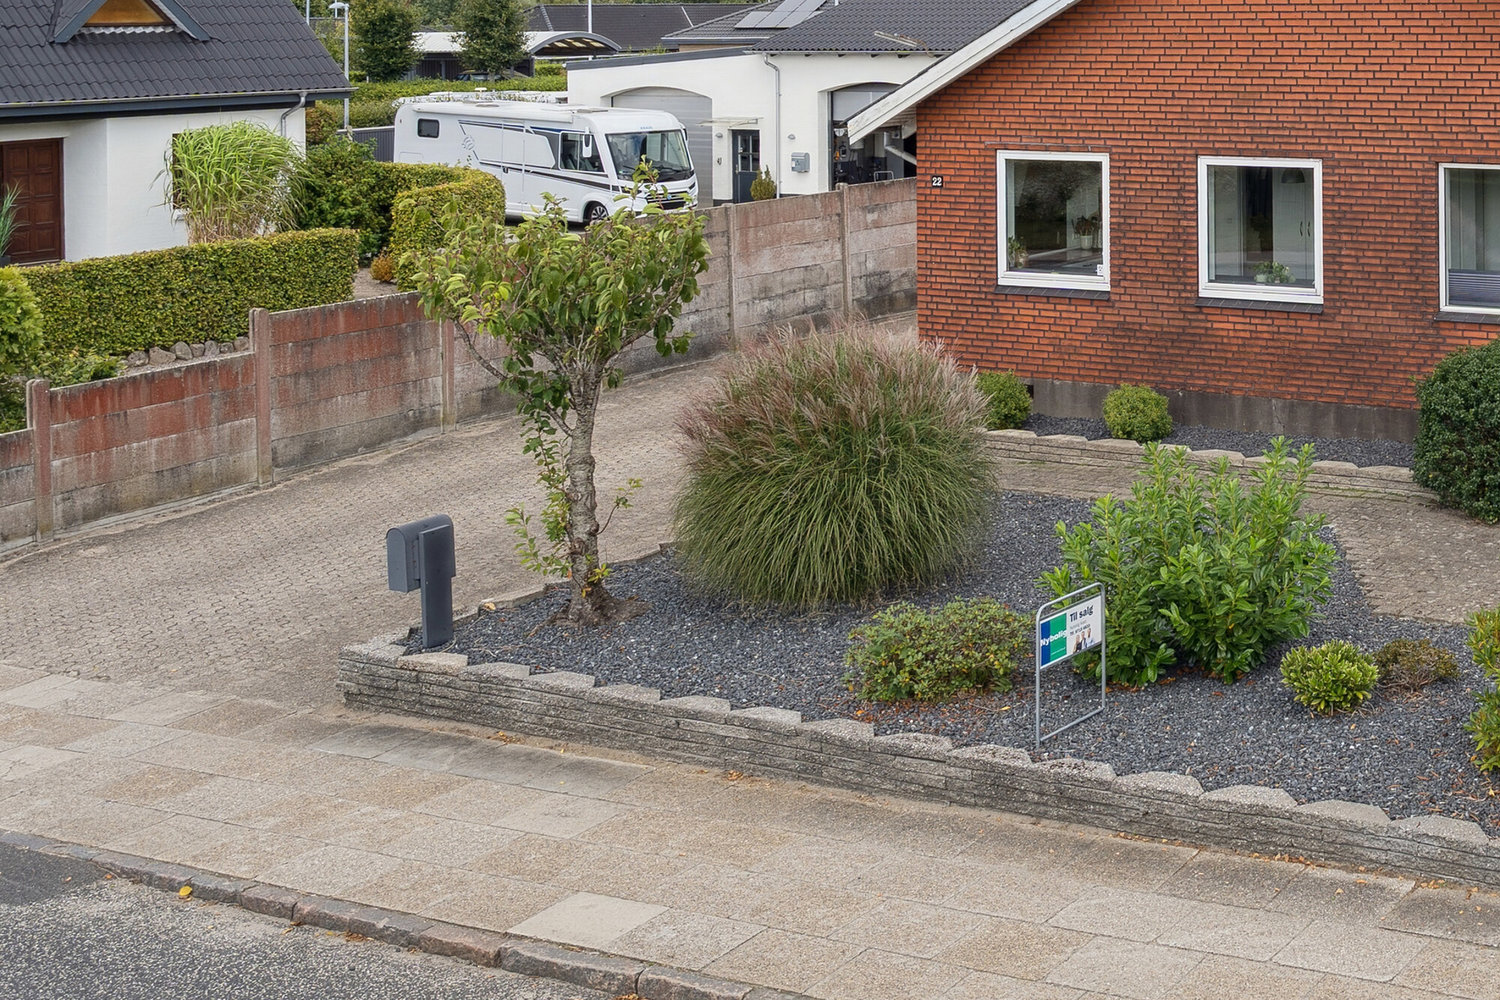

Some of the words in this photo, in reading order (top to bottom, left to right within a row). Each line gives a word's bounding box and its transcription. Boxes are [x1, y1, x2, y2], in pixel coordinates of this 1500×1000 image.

[932, 177, 942, 186] 22
[1070, 611, 1078, 622] Til
[1079, 605, 1093, 618] salg
[1040, 629, 1067, 646] Nybolig
